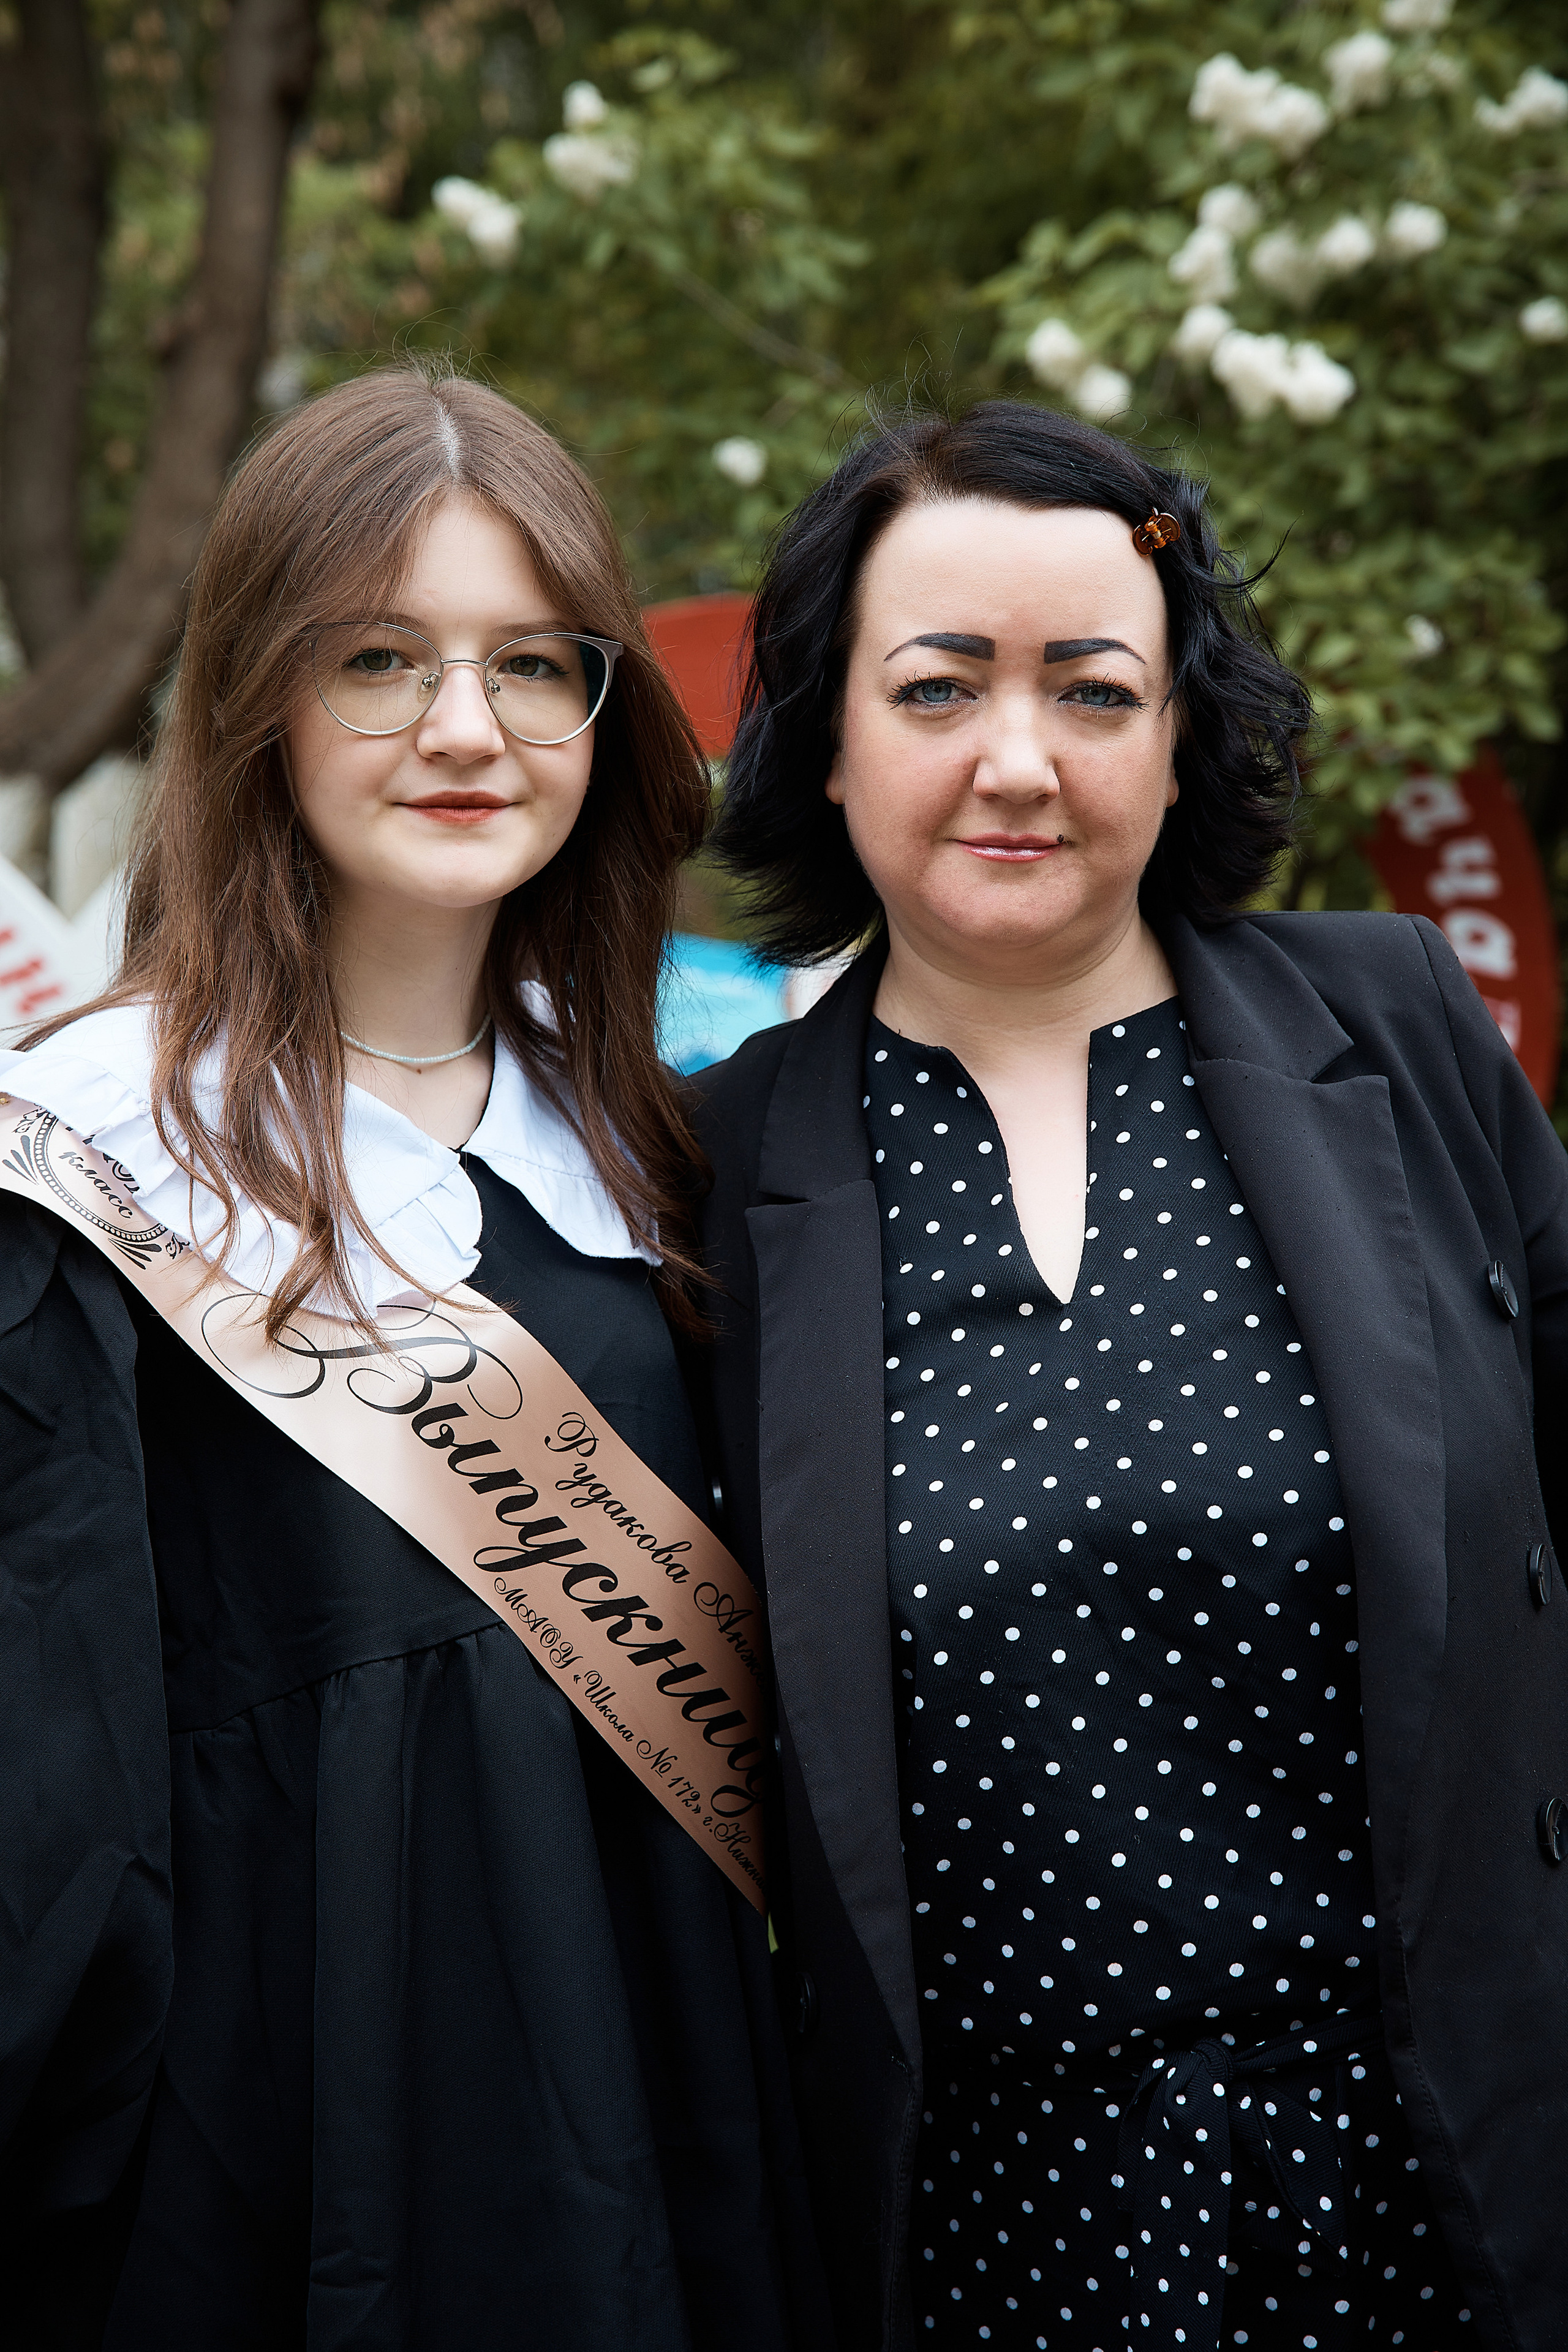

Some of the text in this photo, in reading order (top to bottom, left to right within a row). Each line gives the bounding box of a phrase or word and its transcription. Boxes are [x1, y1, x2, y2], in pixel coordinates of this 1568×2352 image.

[58, 1150, 134, 1219] Класс
[544, 1411, 766, 1694] Рудакова Анже
[494, 1577, 583, 1668] МАОУ
[636, 1740, 678, 1779] №
